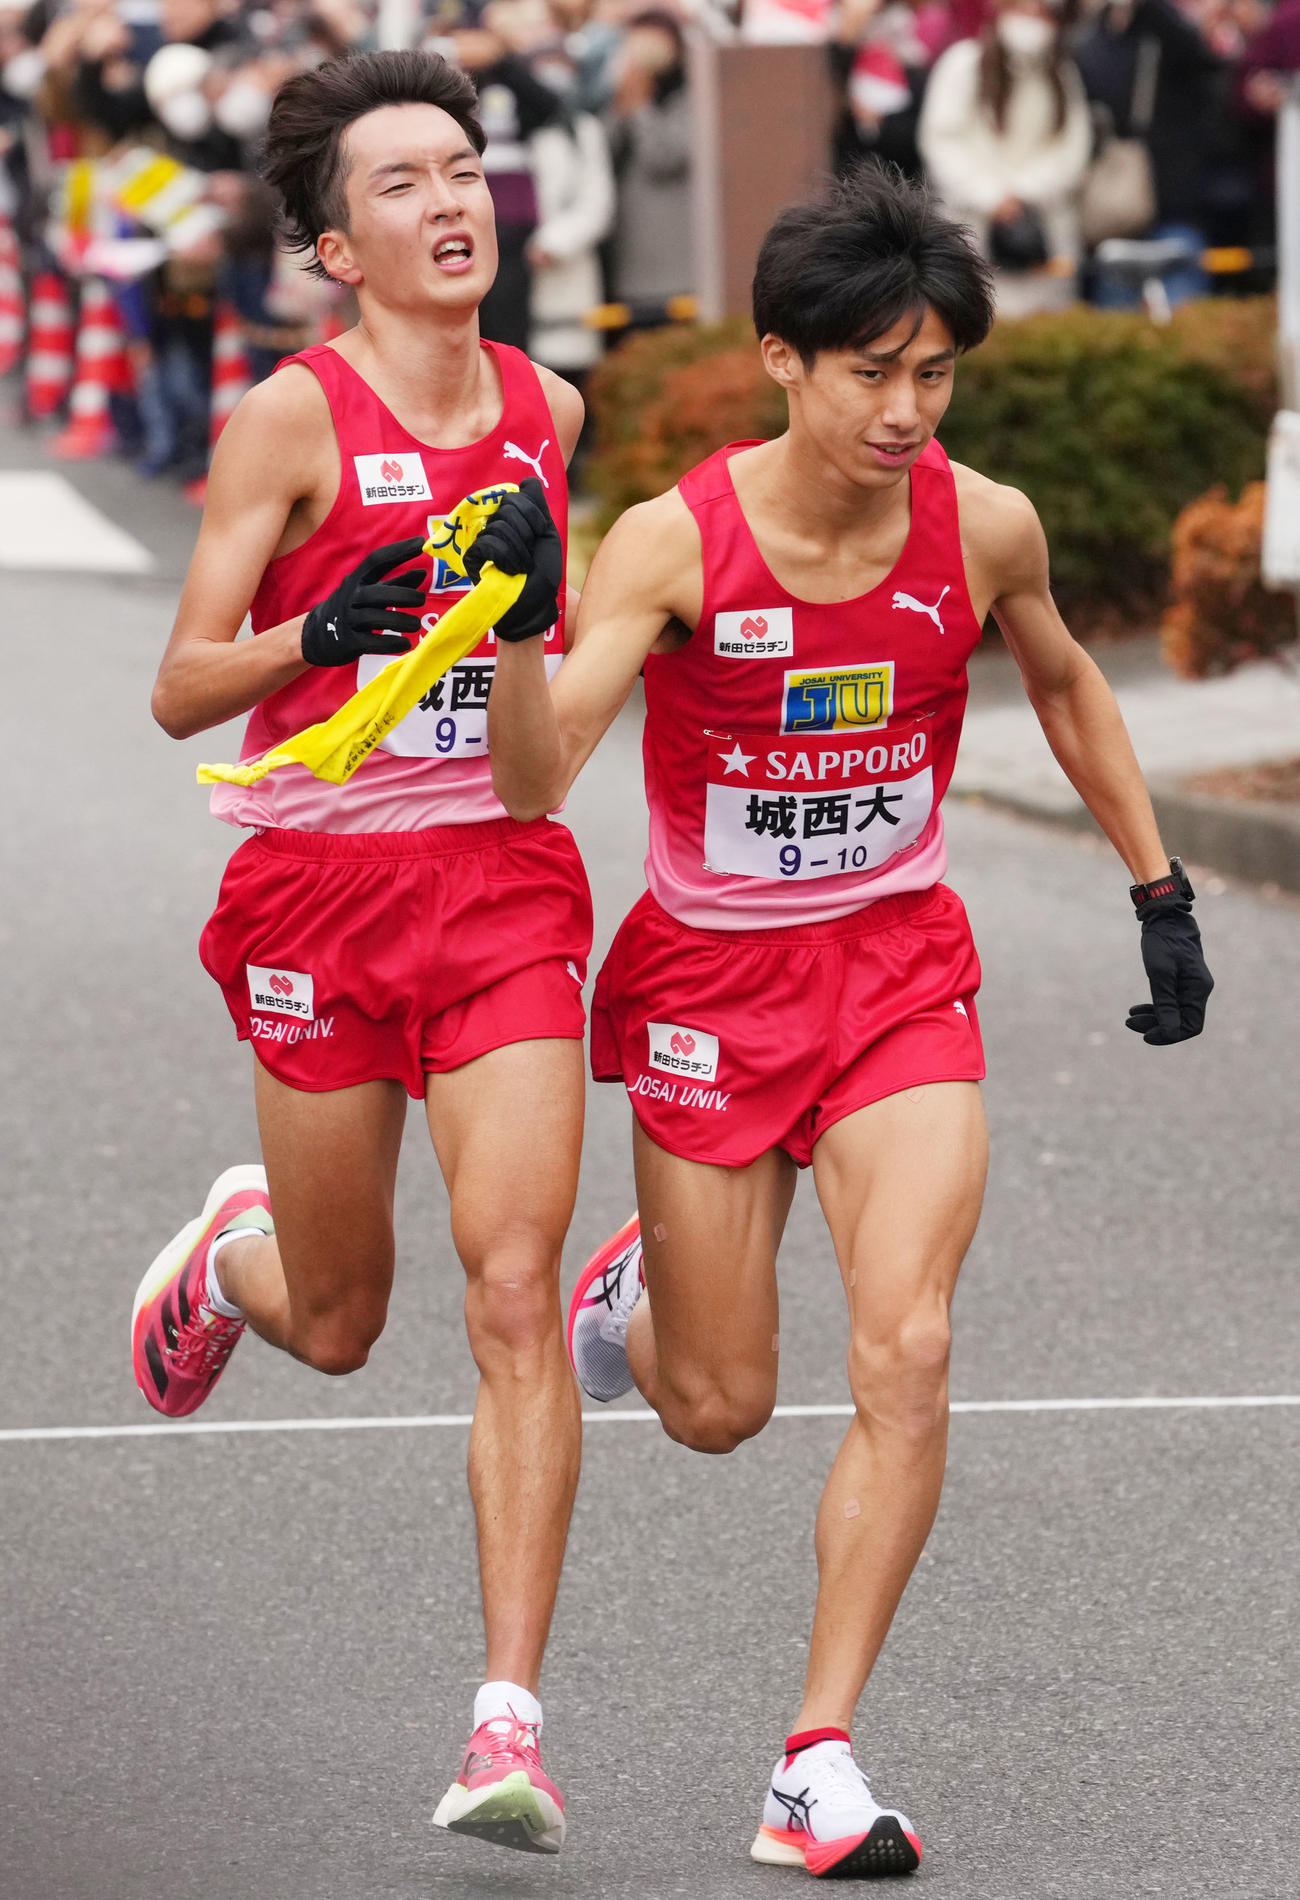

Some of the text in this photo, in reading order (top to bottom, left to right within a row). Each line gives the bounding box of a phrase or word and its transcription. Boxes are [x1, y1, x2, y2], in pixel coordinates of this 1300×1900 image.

[366, 485, 425, 498] 新田ゼラチン
[719, 641, 788, 653] 新田ゼラチン
[800, 671, 883, 685] JOSAI UNIVERSITY
[791, 681, 884, 730] JU
[766, 732, 927, 781] SAPPORO
[745, 786, 903, 839] 城西大
[255, 994, 309, 1013] 新田ゼラチン
[249, 1016, 335, 1044] OSAI UNIV.
[653, 1050, 713, 1075] 新田ゼラチン
[627, 1074, 732, 1111] JOSAI UNIV.
